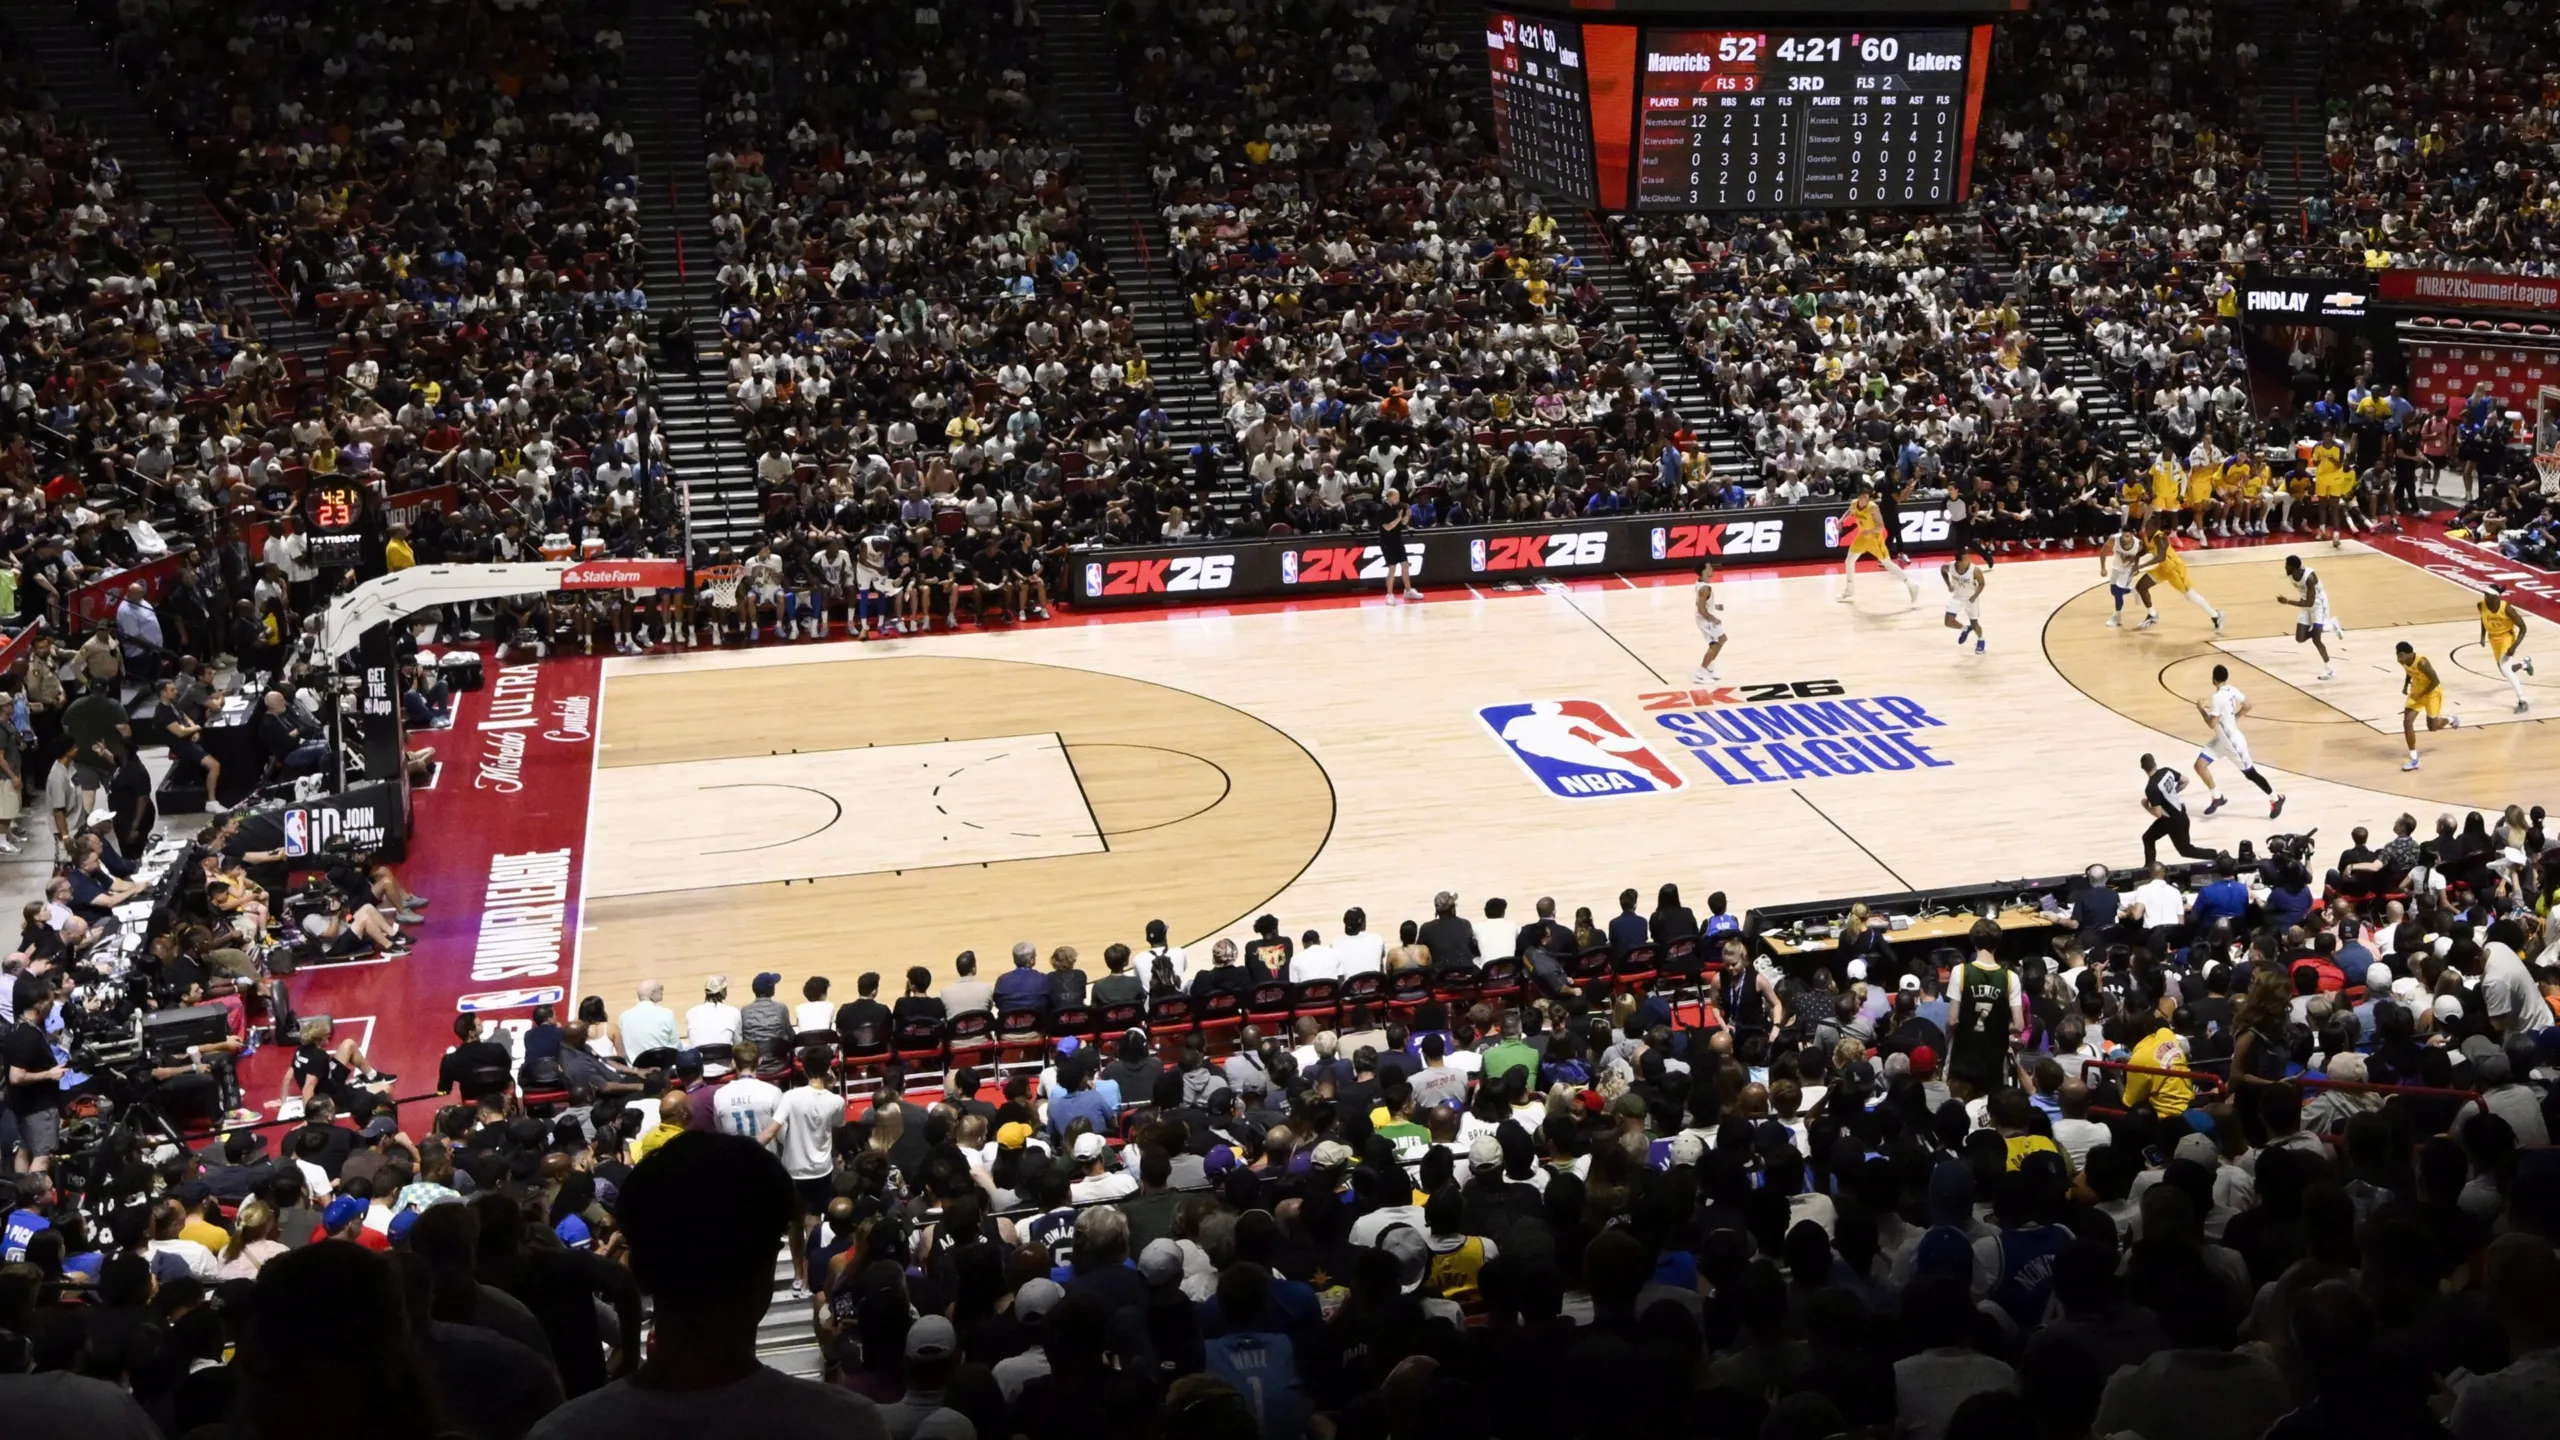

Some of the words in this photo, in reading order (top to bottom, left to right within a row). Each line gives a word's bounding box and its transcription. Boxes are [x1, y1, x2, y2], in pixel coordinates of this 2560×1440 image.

[1503, 20, 1515, 43] 52
[1519, 24, 1539, 49] 4:21
[1543, 29, 1556, 53] 60
[1718, 37, 1756, 62] 52
[1776, 37, 1841, 62] 4:21
[1861, 37, 1898, 62] 60
[1648, 53, 1711, 72] Mavericks
[1908, 52, 1962, 71] Lakers
[1716, 78, 1736, 90] FLS
[1744, 77, 1754, 91] 3
[1788, 76, 1825, 91] 3RD
[1856, 77, 1875, 89] FLS
[1882, 76, 1893, 90] 2
[1650, 98, 1680, 107] PLAYER
[1692, 97, 1708, 107] PTS
[1721, 97, 1737, 106] RBS
[1750, 97, 1765, 106] AST
[1778, 97, 1792, 106] FLS
[1812, 97, 1841, 106] PLAYER
[1853, 97, 1868, 105] PTS
[1881, 96, 1897, 105] RBS
[1909, 96, 1924, 105] AST
[1936, 95, 1950, 105] FLS
[1691, 114, 1707, 128] 12
[1723, 114, 1732, 127] 2
[1753, 113, 1760, 127] 1
[1781, 113, 1788, 127] 1
[1852, 112, 1867, 126] 13
[1883, 112, 1892, 126] 2
[1912, 112, 1919, 125] 1
[1937, 112, 1946, 125] 0
[1644, 137, 1684, 145] Cleveland
[1693, 133, 1702, 147] 2
[1722, 133, 1731, 146] 4
[1752, 132, 1759, 146] 1
[1779, 132, 1787, 145] 1
[1854, 131, 1862, 145] 9
[1881, 131, 1890, 144] 4
[1909, 131, 1918, 144] 4
[1936, 130, 1943, 143] 1
[1692, 153, 1700, 166] 0
[1721, 152, 1729, 166] 3
[1749, 152, 1758, 166] 3
[1777, 152, 1786, 165] 3
[1807, 155, 1837, 163] Gordon
[1852, 150, 1860, 164] 0
[1880, 150, 1888, 163] 0
[1908, 150, 1916, 163] 0
[1934, 150, 1942, 163] 2
[1690, 171, 1699, 185] 6
[1719, 171, 1728, 185] 2
[1748, 171, 1757, 184] 0
[1775, 170, 1784, 183] 4
[1851, 169, 1859, 182] 2
[1879, 169, 1887, 182] 3
[1906, 168, 1915, 181] 2
[1933, 168, 1940, 181] 1
[1689, 190, 1698, 204] 3
[1719, 190, 1726, 203] 1
[1747, 189, 1756, 203] 0
[1774, 189, 1783, 202] 0
[1849, 188, 1858, 200] 0
[1877, 187, 1885, 200] 0
[1905, 187, 1913, 199] 0
[1931, 186, 1939, 199] 0
[2415, 276, 2557, 306] #NBA2KSummerLeague
[2247, 291, 2309, 312] FINDLAY
[322, 490, 357, 505] 4:21
[319, 505, 350, 526] 23
[324, 534, 361, 544] TISSOT
[1666, 520, 1783, 559] 2K26
[1487, 531, 1608, 571] 2K26
[582, 571, 612, 583] State
[612, 570, 641, 582] Farm
[1102, 555, 1235, 596] 2K26
[368, 668, 386, 683] GET
[368, 683, 387, 698] THE
[489, 663, 540, 718] ULTRA
[1637, 678, 1846, 711] 2K26
[373, 699, 392, 716] App
[543, 696, 590, 742] Courtside
[1655, 695, 1948, 747] SUMMER
[474, 731, 526, 793] Michelob
[1690, 732, 1955, 787] LEAGUE
[1556, 773, 1638, 795] NBA
[342, 806, 374, 829] JOIN
[484, 848, 571, 908] LEAGUE
[471, 902, 565, 981] SUMMER
[1970, 984, 2001, 1000] LEWIS
[1974, 1002, 1993, 1032] 7
[731, 1109, 757, 1136] 11
[1467, 1129, 1497, 1141] BRYAN
[1228, 1348, 1268, 1371] WALL
